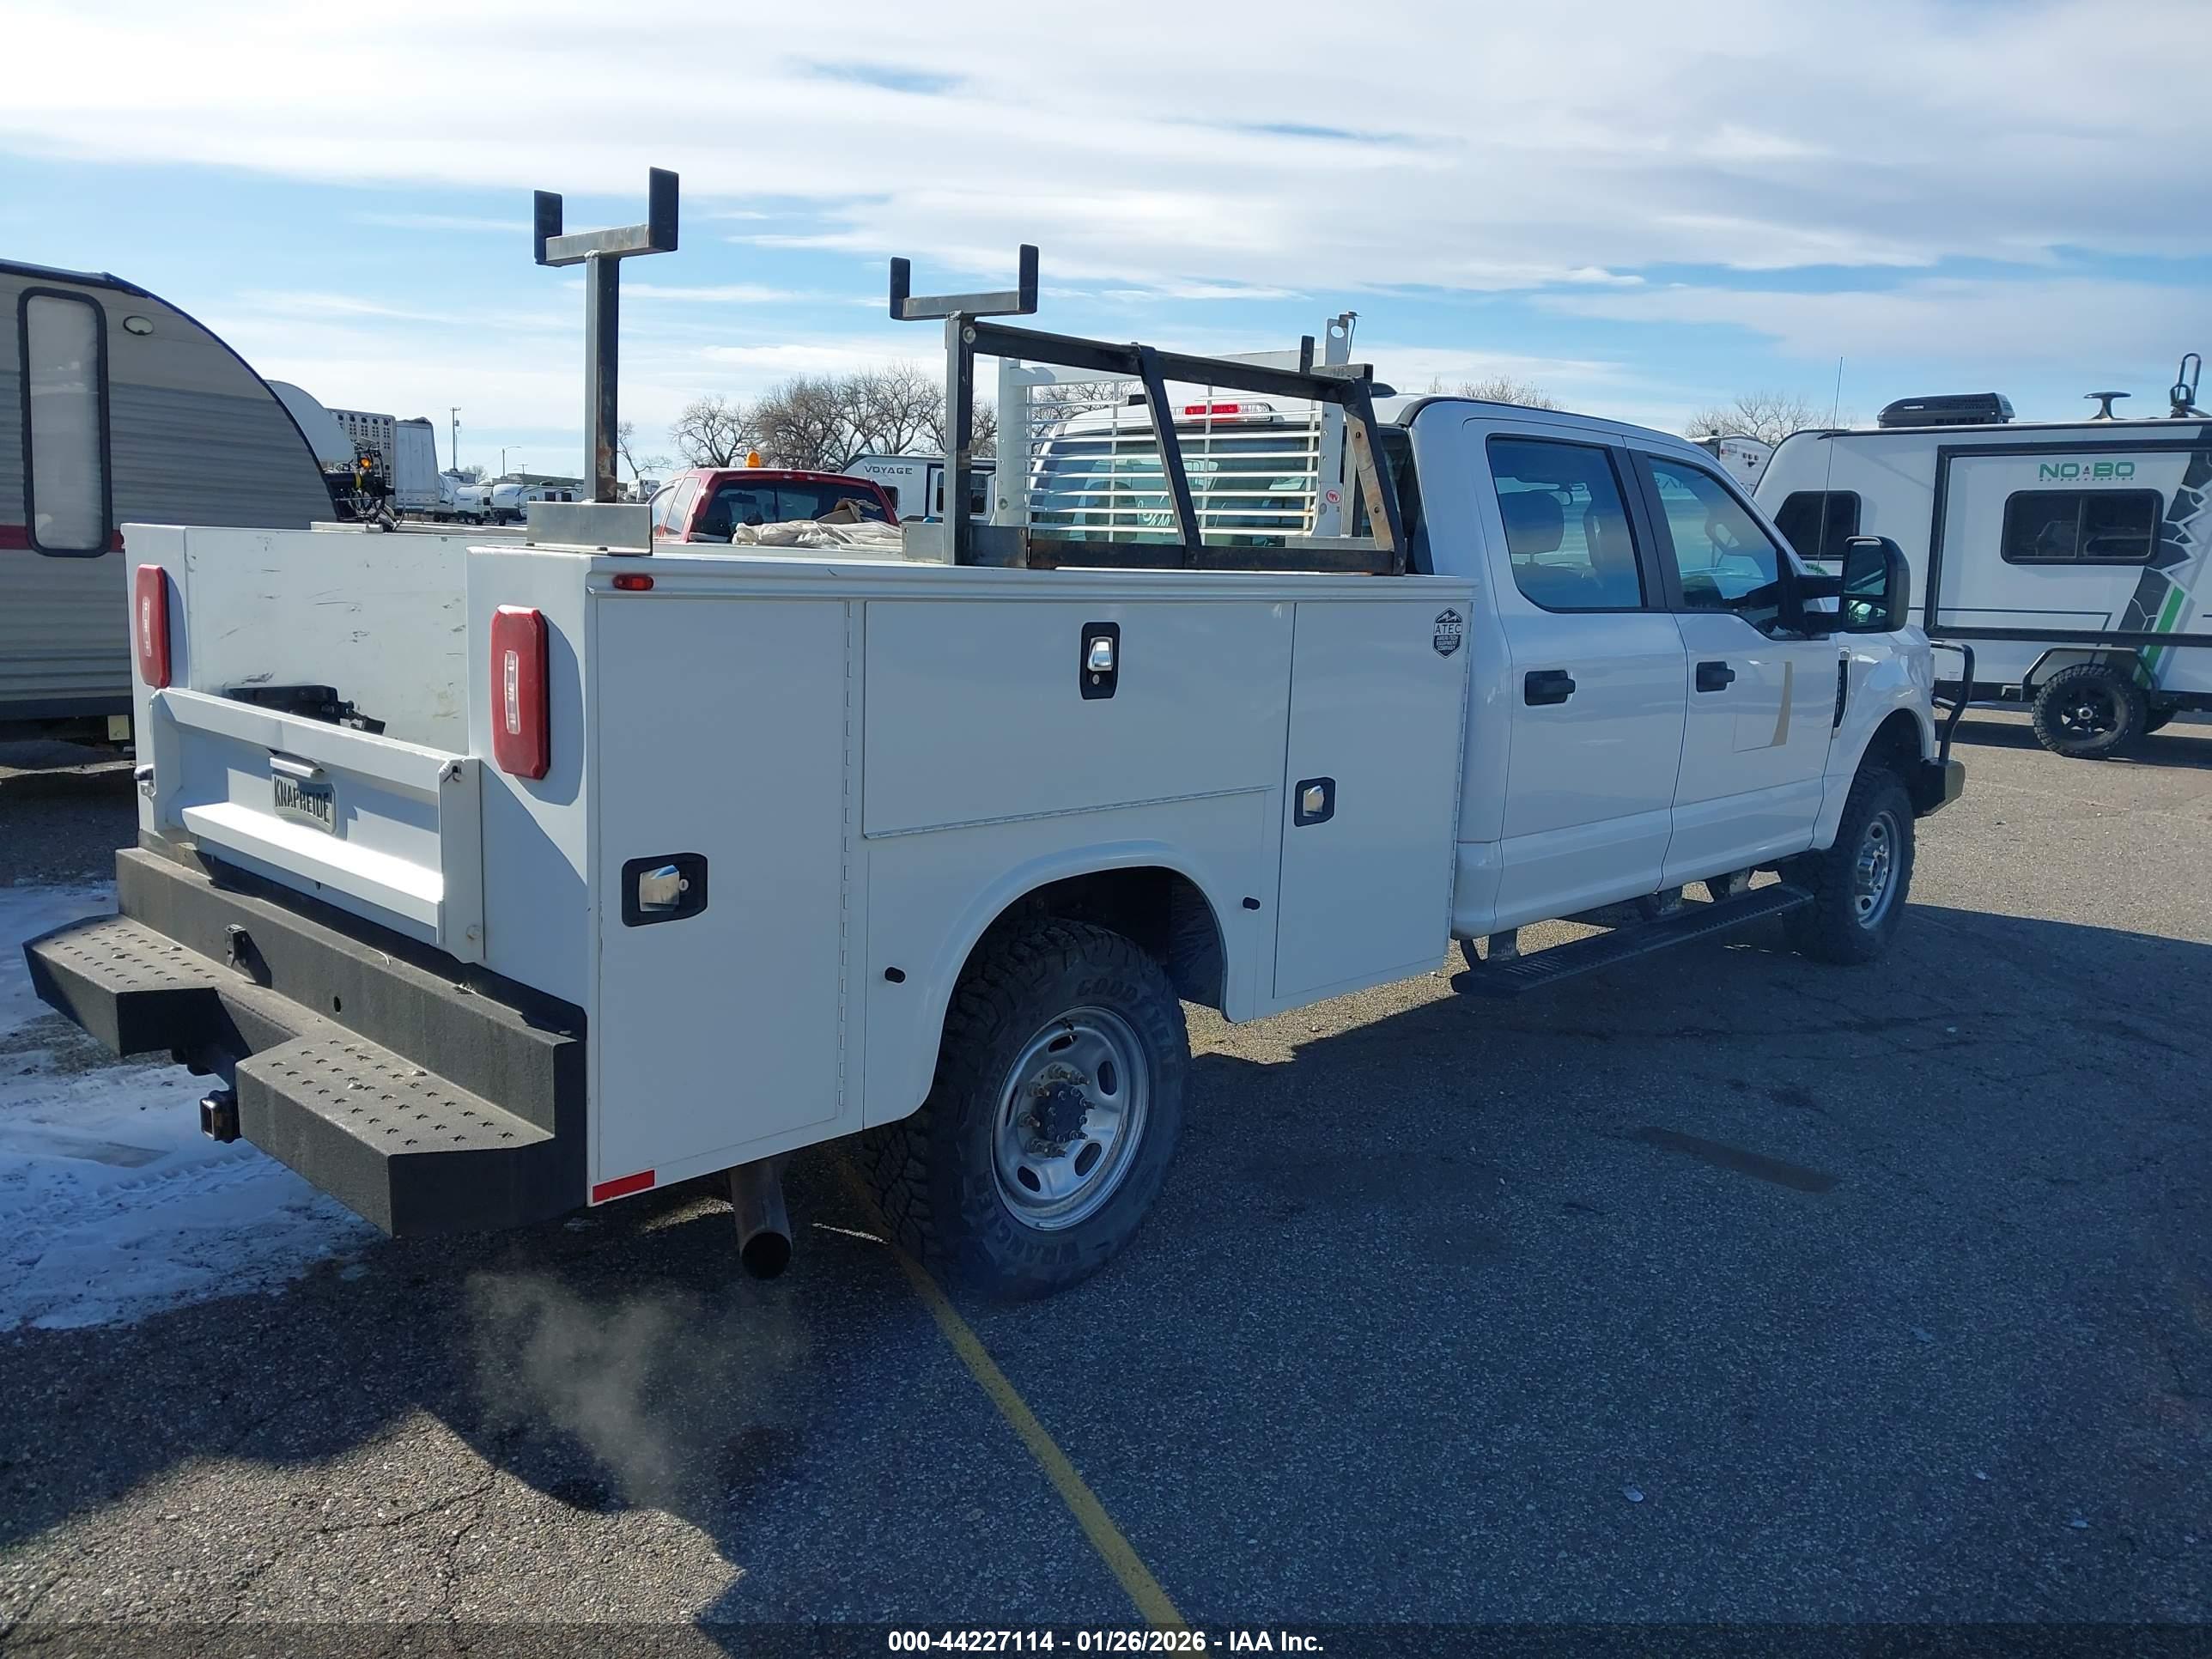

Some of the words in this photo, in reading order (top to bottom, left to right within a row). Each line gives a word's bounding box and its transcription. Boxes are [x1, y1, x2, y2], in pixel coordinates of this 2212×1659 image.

[864, 465, 913, 475] VOYAGE
[2039, 462, 2080, 478] NO
[2094, 461, 2136, 477] BO
[1435, 623, 1462, 634] ATEC
[274, 775, 331, 823] KNAPHEIDE
